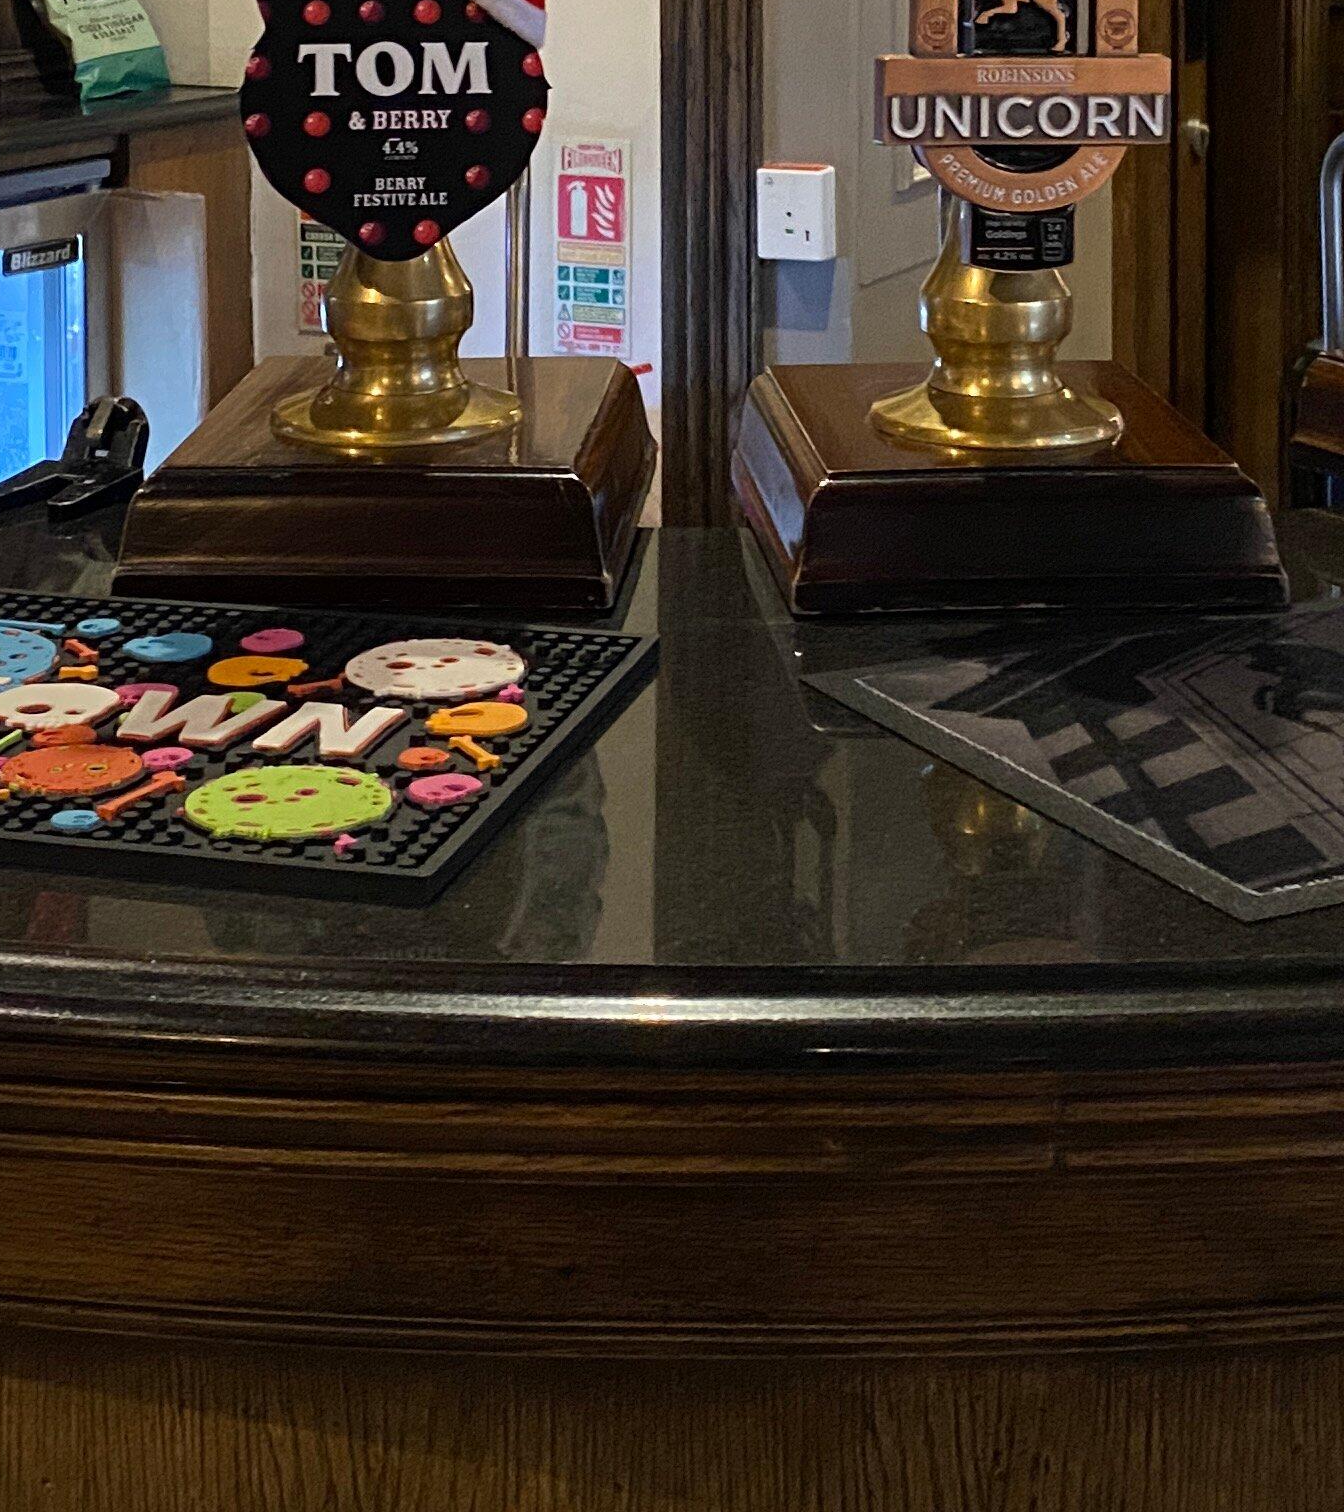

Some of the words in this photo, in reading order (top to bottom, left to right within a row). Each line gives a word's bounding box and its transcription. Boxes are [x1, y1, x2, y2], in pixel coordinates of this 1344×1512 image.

[297, 41, 493, 97] TOM
[977, 67, 1077, 83] ROBINSONS
[348, 111, 366, 130] &
[372, 109, 452, 130] BERRY
[890, 95, 1166, 140] UNICORN
[374, 176, 427, 191] BERRY
[938, 153, 1006, 203] PREMIUM
[1011, 176, 1079, 205] GOLDEN
[1079, 150, 1109, 182] ALE
[353, 192, 416, 207] FESTIVE
[417, 191, 448, 206] ALE
[10, 244, 72, 271] Blizzard
